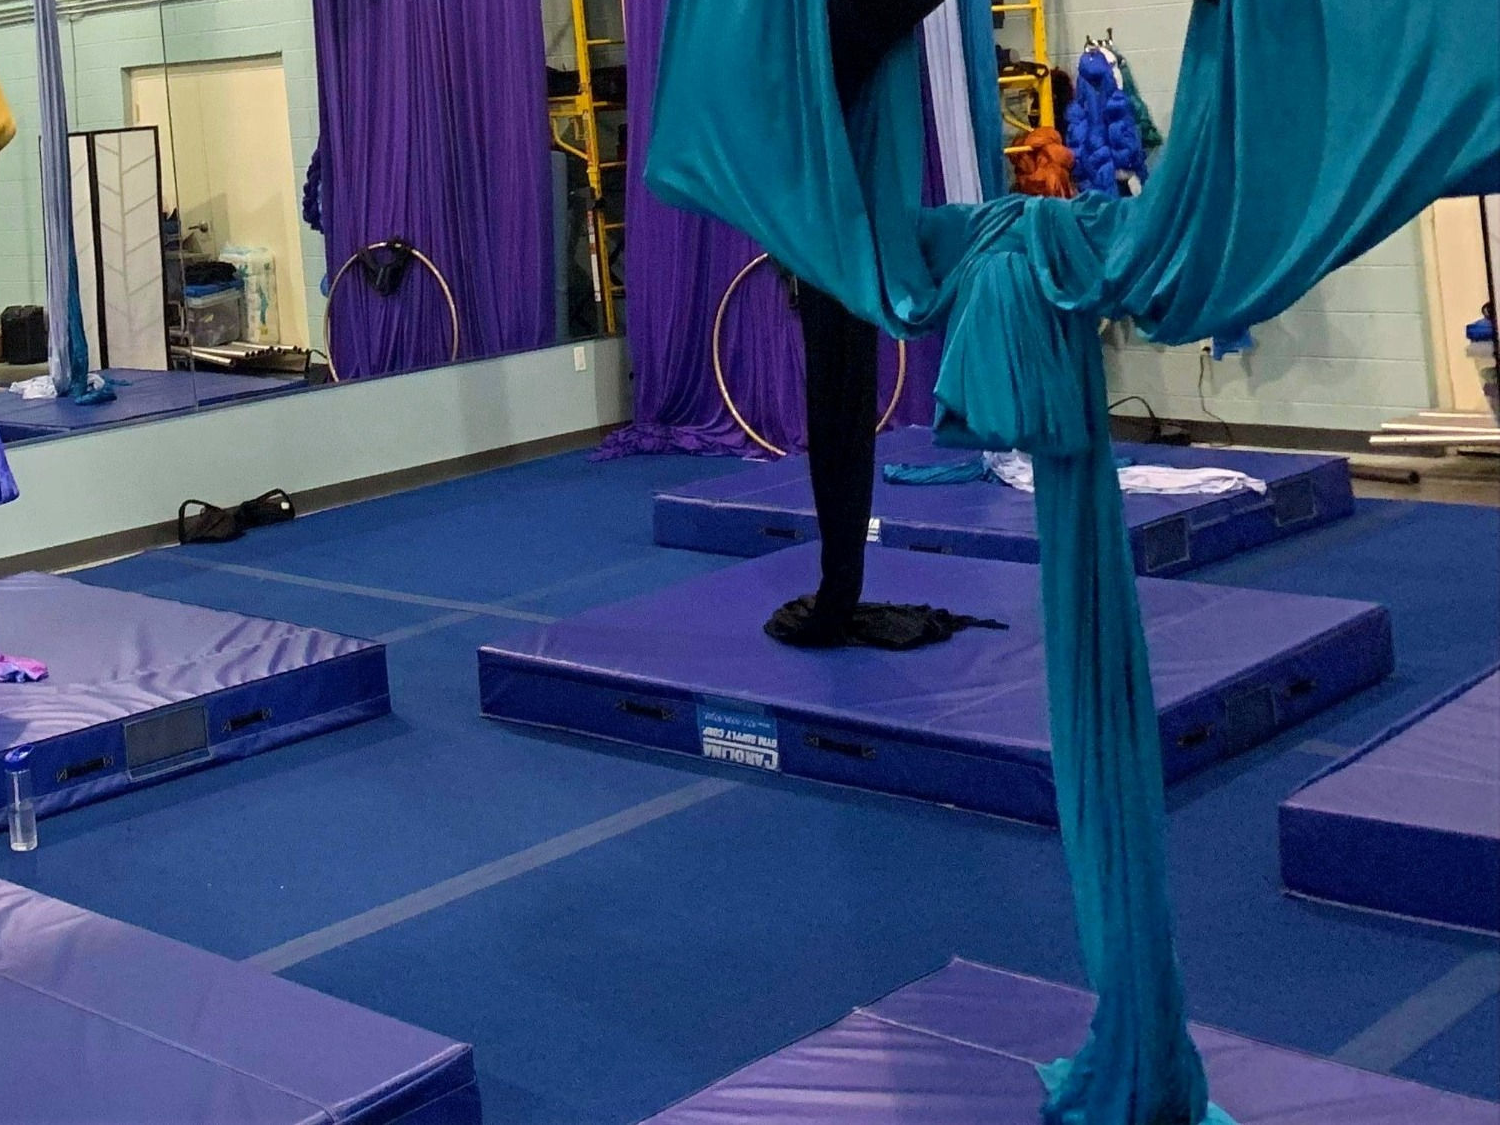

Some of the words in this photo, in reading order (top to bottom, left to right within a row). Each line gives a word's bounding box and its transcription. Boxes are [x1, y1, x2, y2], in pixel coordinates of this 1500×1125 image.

[725, 730, 757, 745] SUPPLY
[758, 736, 778, 749] GYM
[703, 742, 779, 770] CAROLINA
